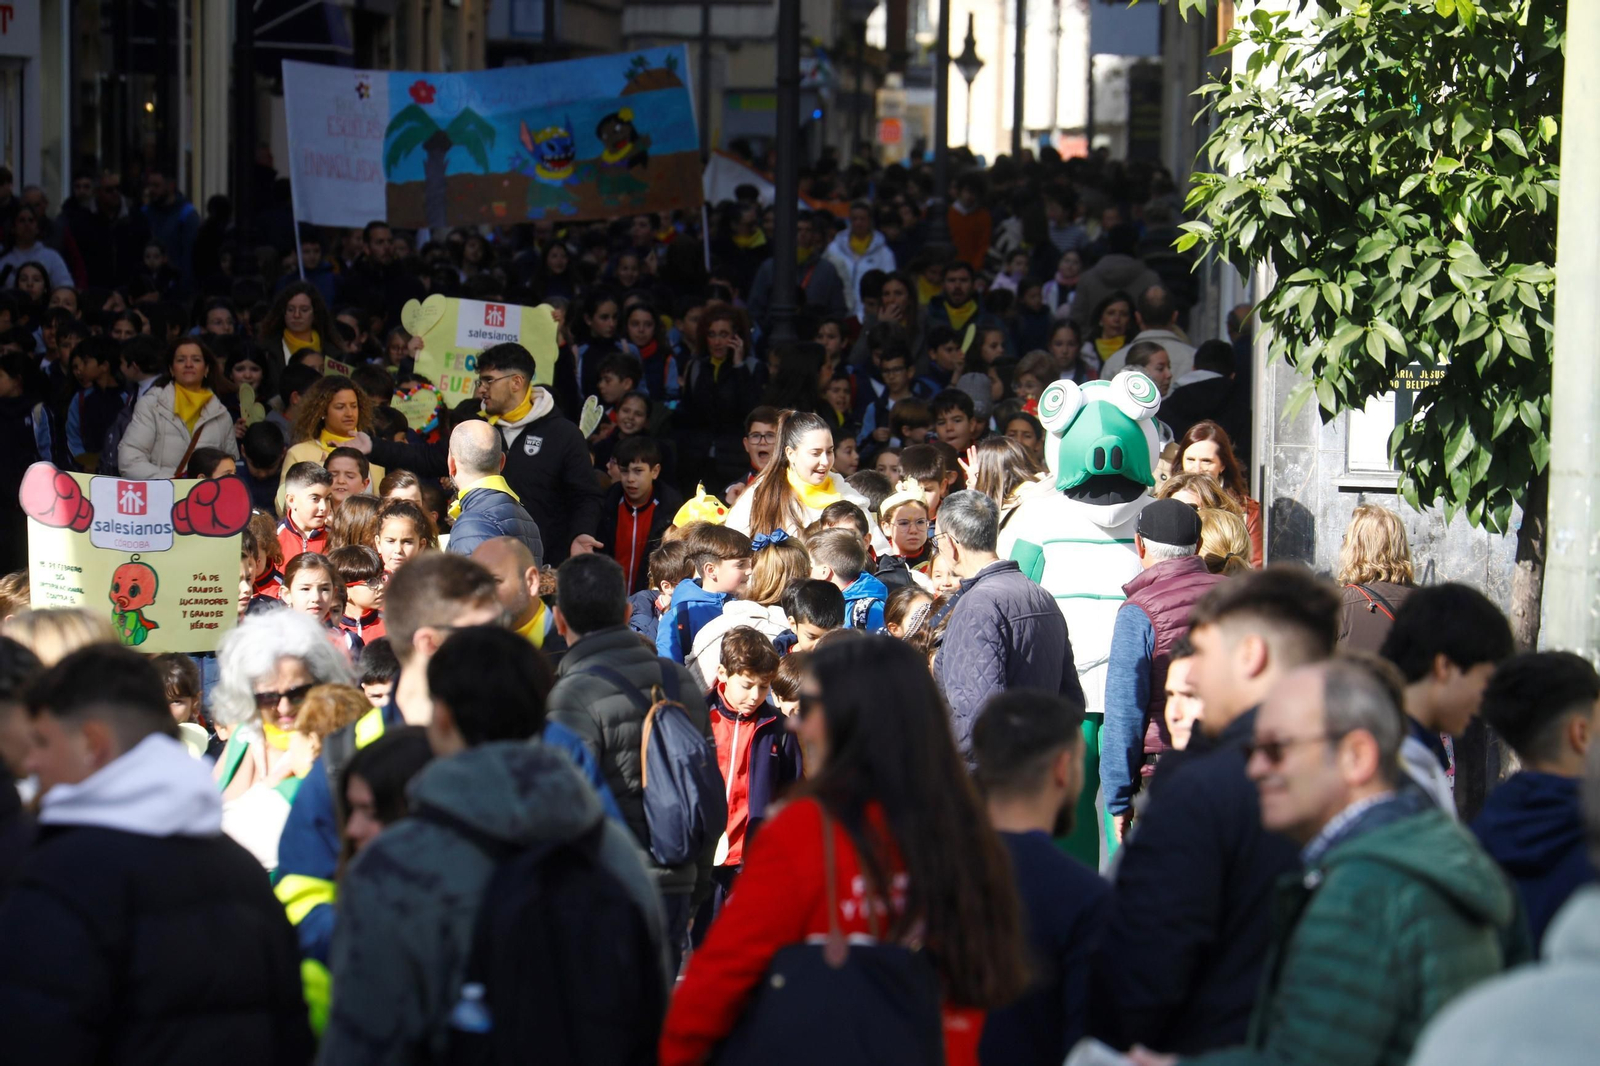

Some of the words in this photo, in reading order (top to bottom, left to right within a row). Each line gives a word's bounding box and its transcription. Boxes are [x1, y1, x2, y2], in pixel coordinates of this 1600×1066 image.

[468, 328, 518, 342] salesianos
[440, 374, 476, 394] GUE
[94, 519, 172, 535] salesianos
[182, 610, 187, 618] Y
[190, 610, 224, 618] GRANDES
